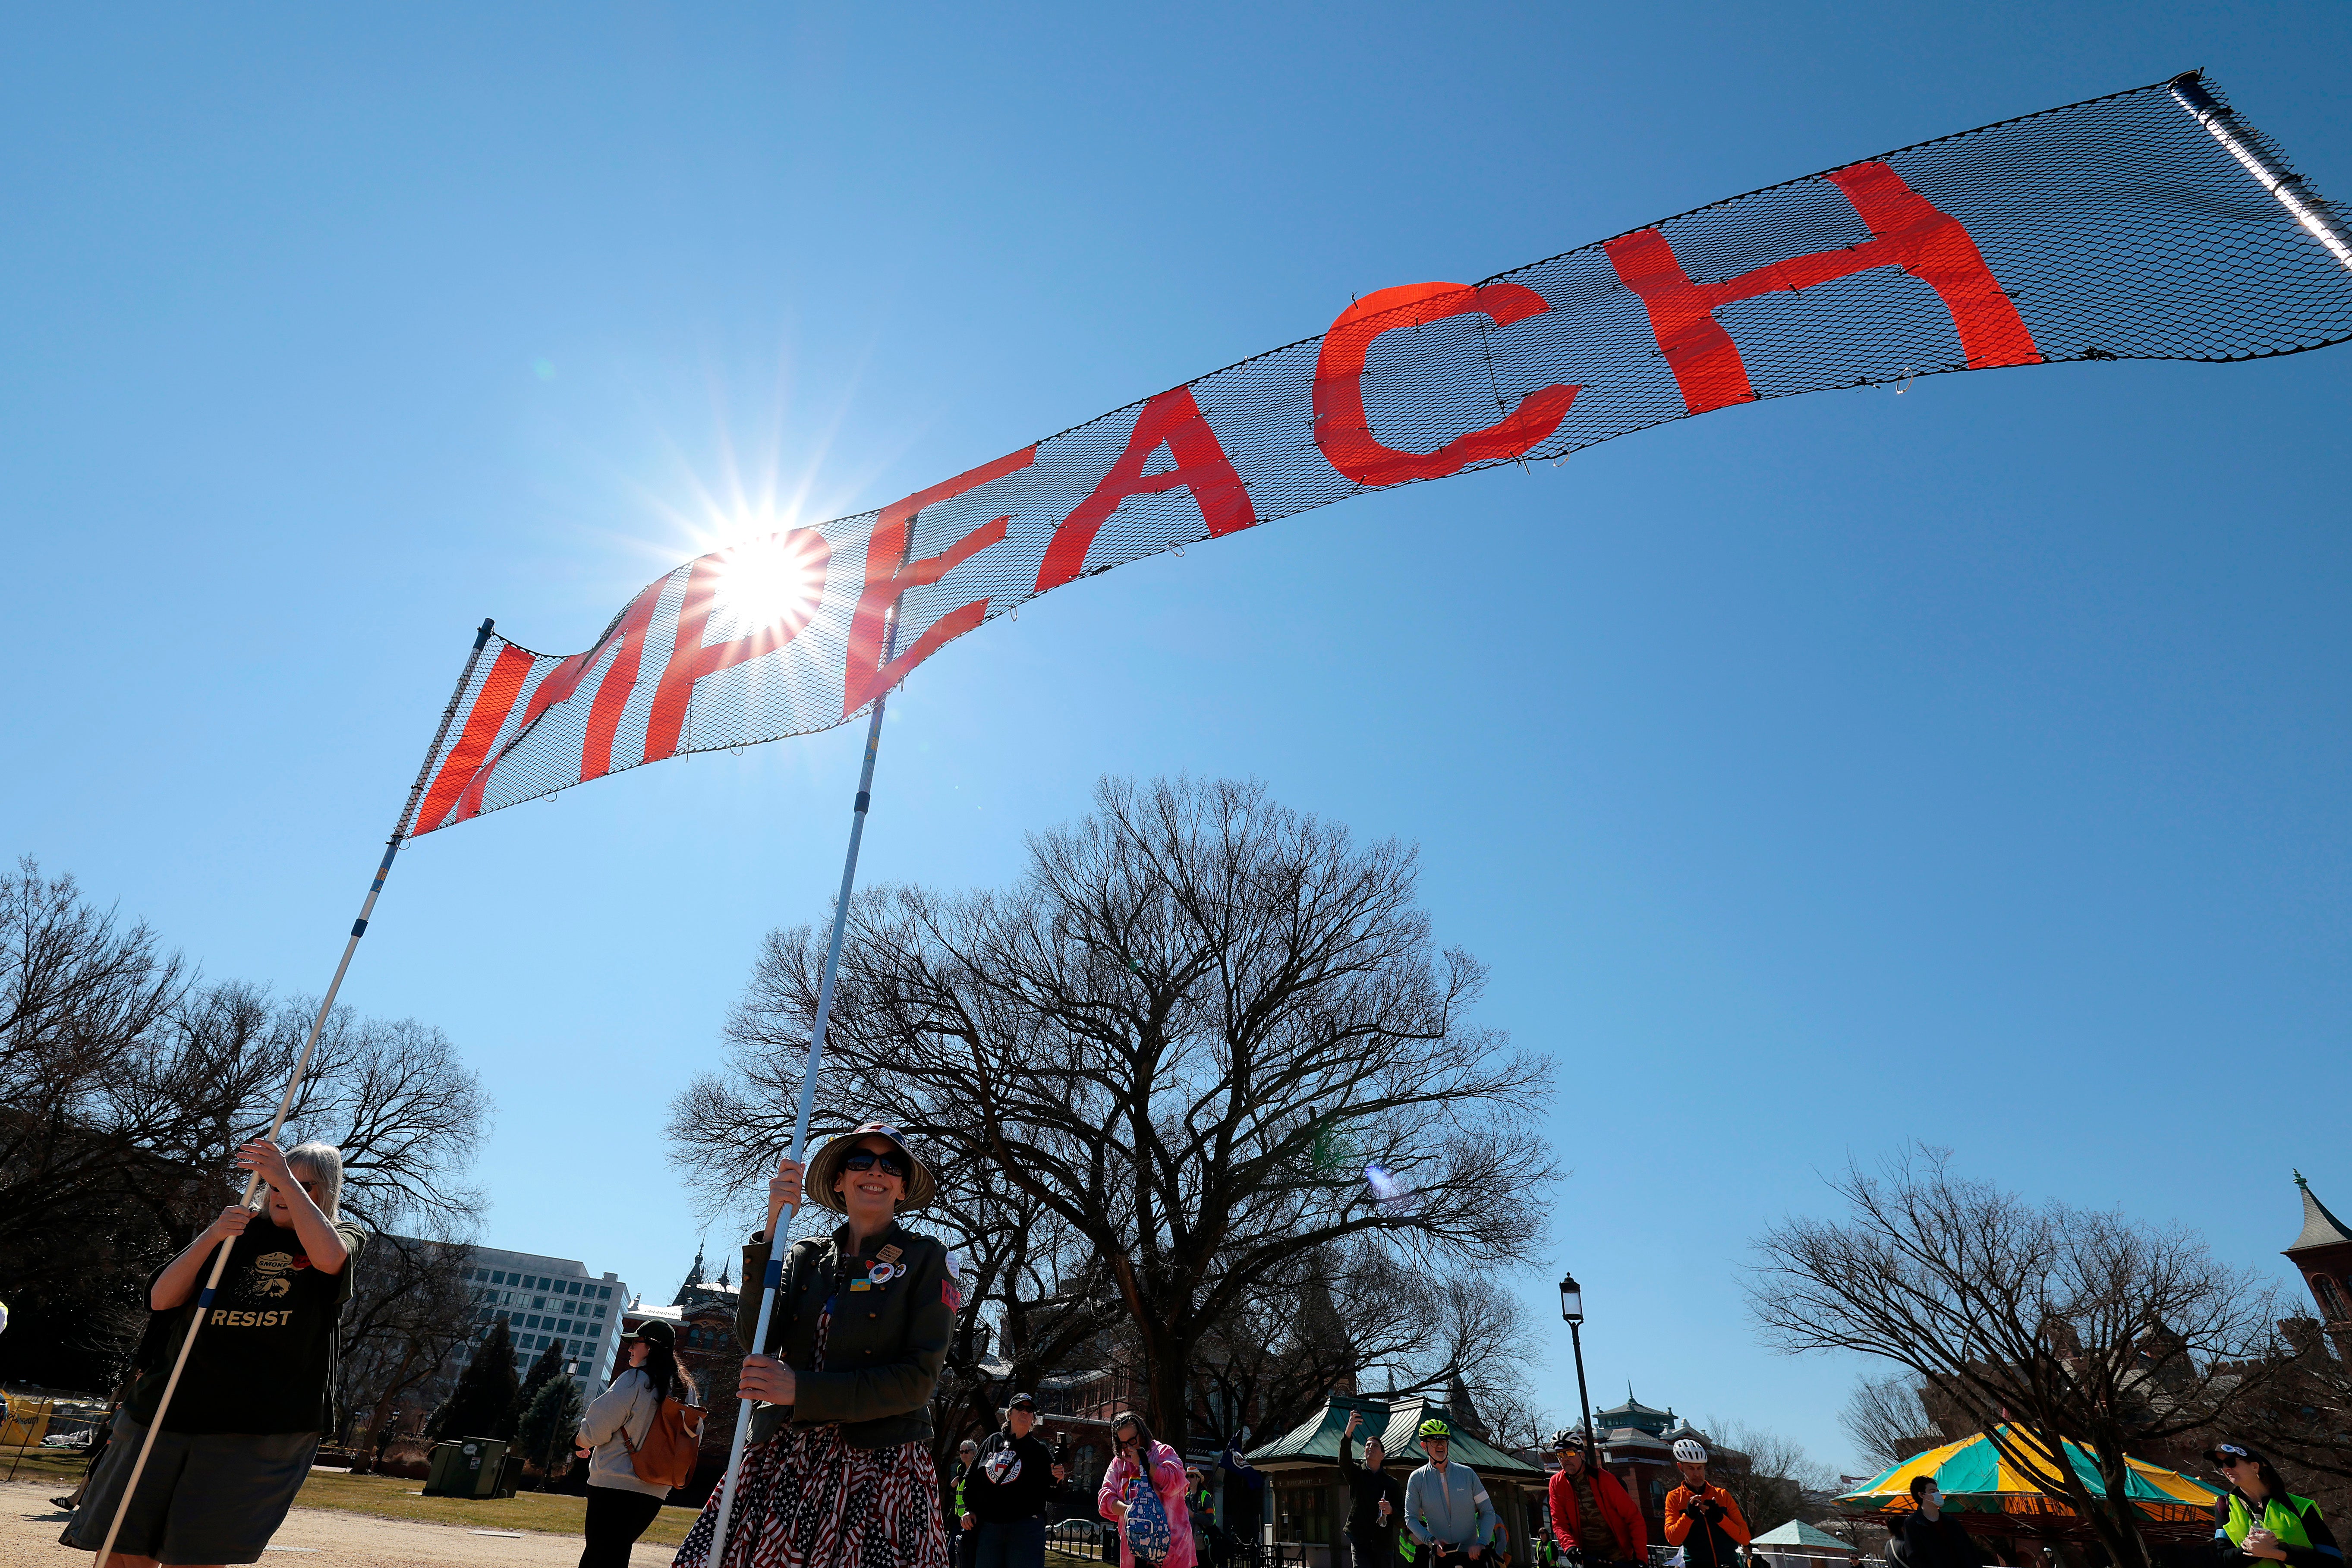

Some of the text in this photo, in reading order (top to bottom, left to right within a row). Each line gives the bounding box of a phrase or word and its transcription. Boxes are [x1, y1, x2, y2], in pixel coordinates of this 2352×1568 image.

[412, 161, 2043, 837] IMPEACH
[211, 1310, 293, 1326] RESIST
[986, 1466, 1020, 1483] PROTTORS
